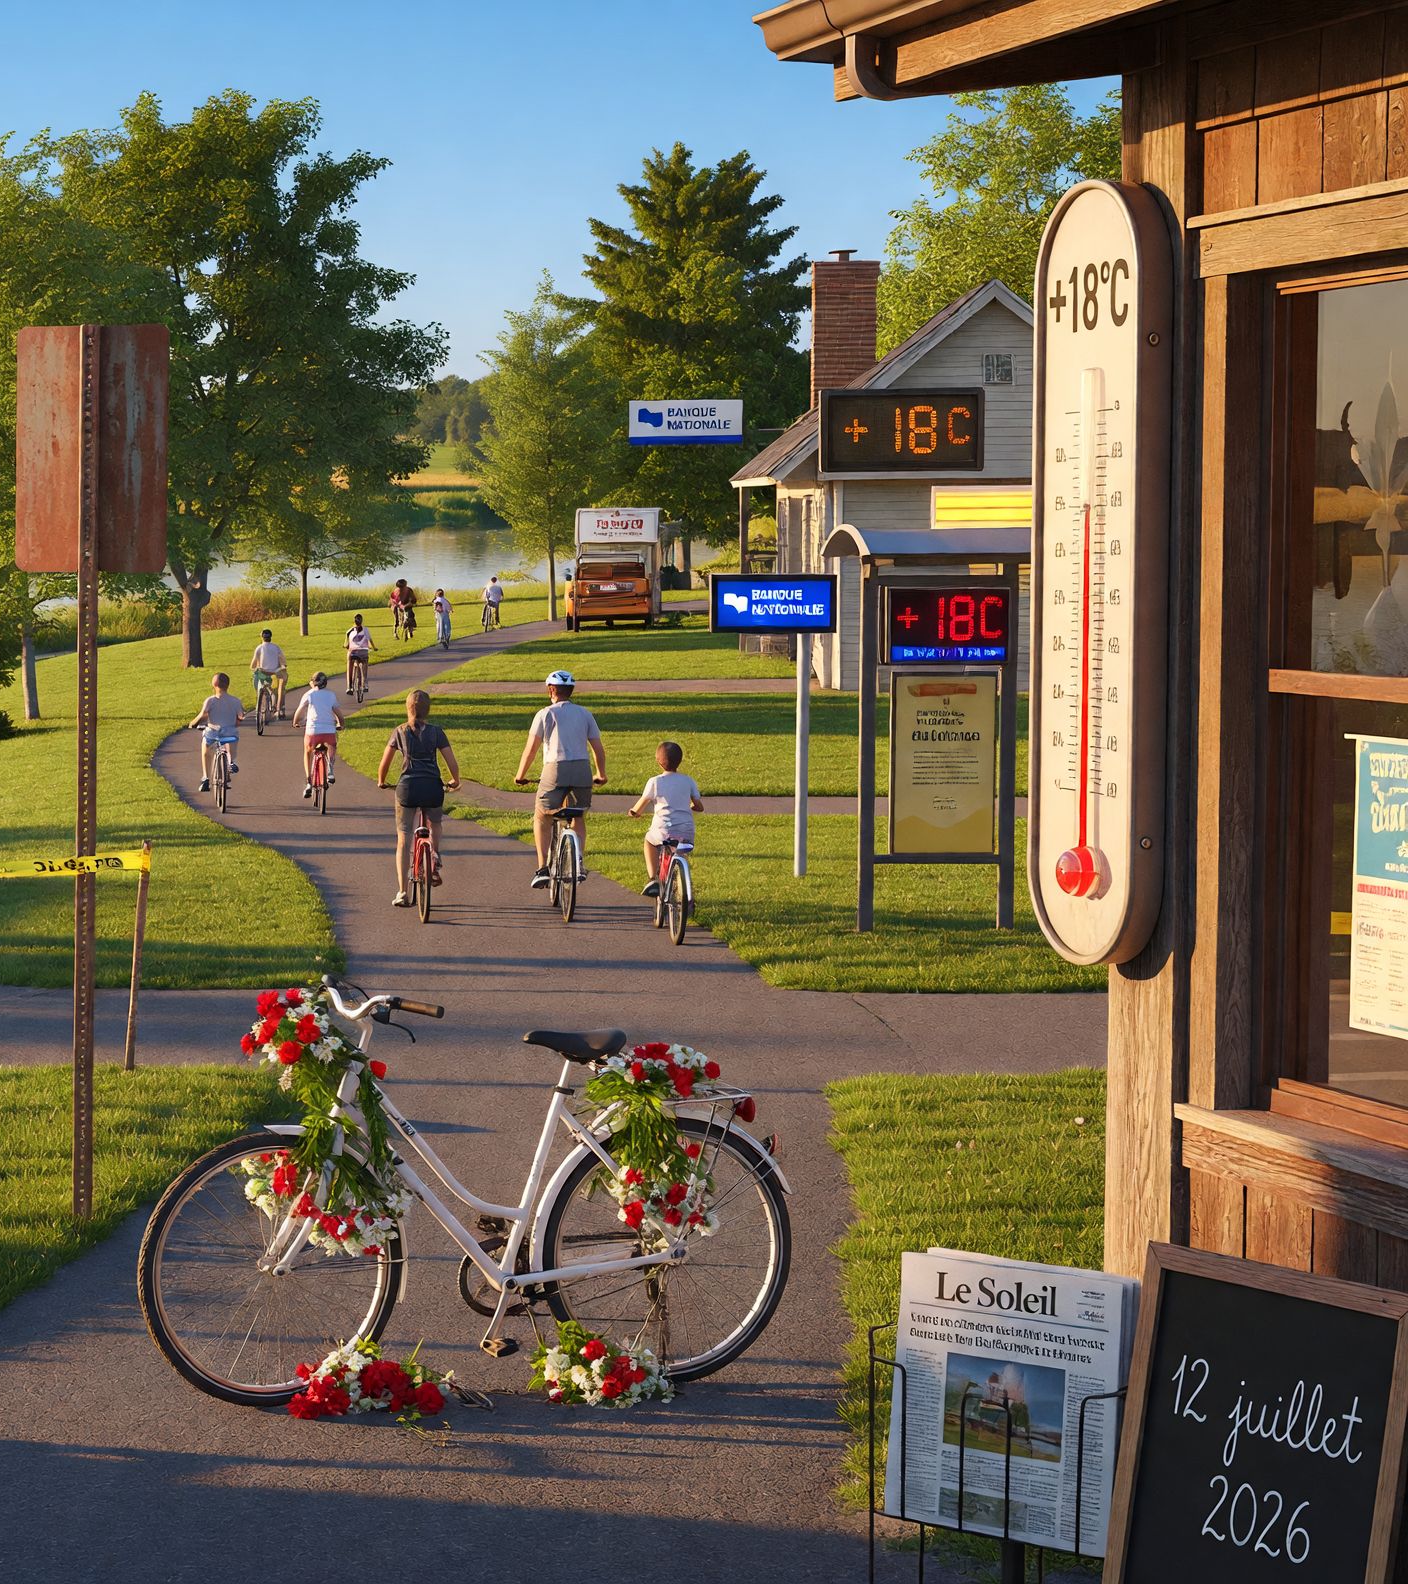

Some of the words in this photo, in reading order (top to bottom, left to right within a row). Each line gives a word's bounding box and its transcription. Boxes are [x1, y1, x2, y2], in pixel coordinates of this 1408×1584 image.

[1050, 258, 1129, 333] +18°C
[934, 1271, 972, 1304] Le
[977, 1276, 1059, 1318] Soleil
[1171, 1354, 1210, 1423] 12
[1222, 1380, 1363, 1467] juillet
[1201, 1475, 1311, 1564] 2026
